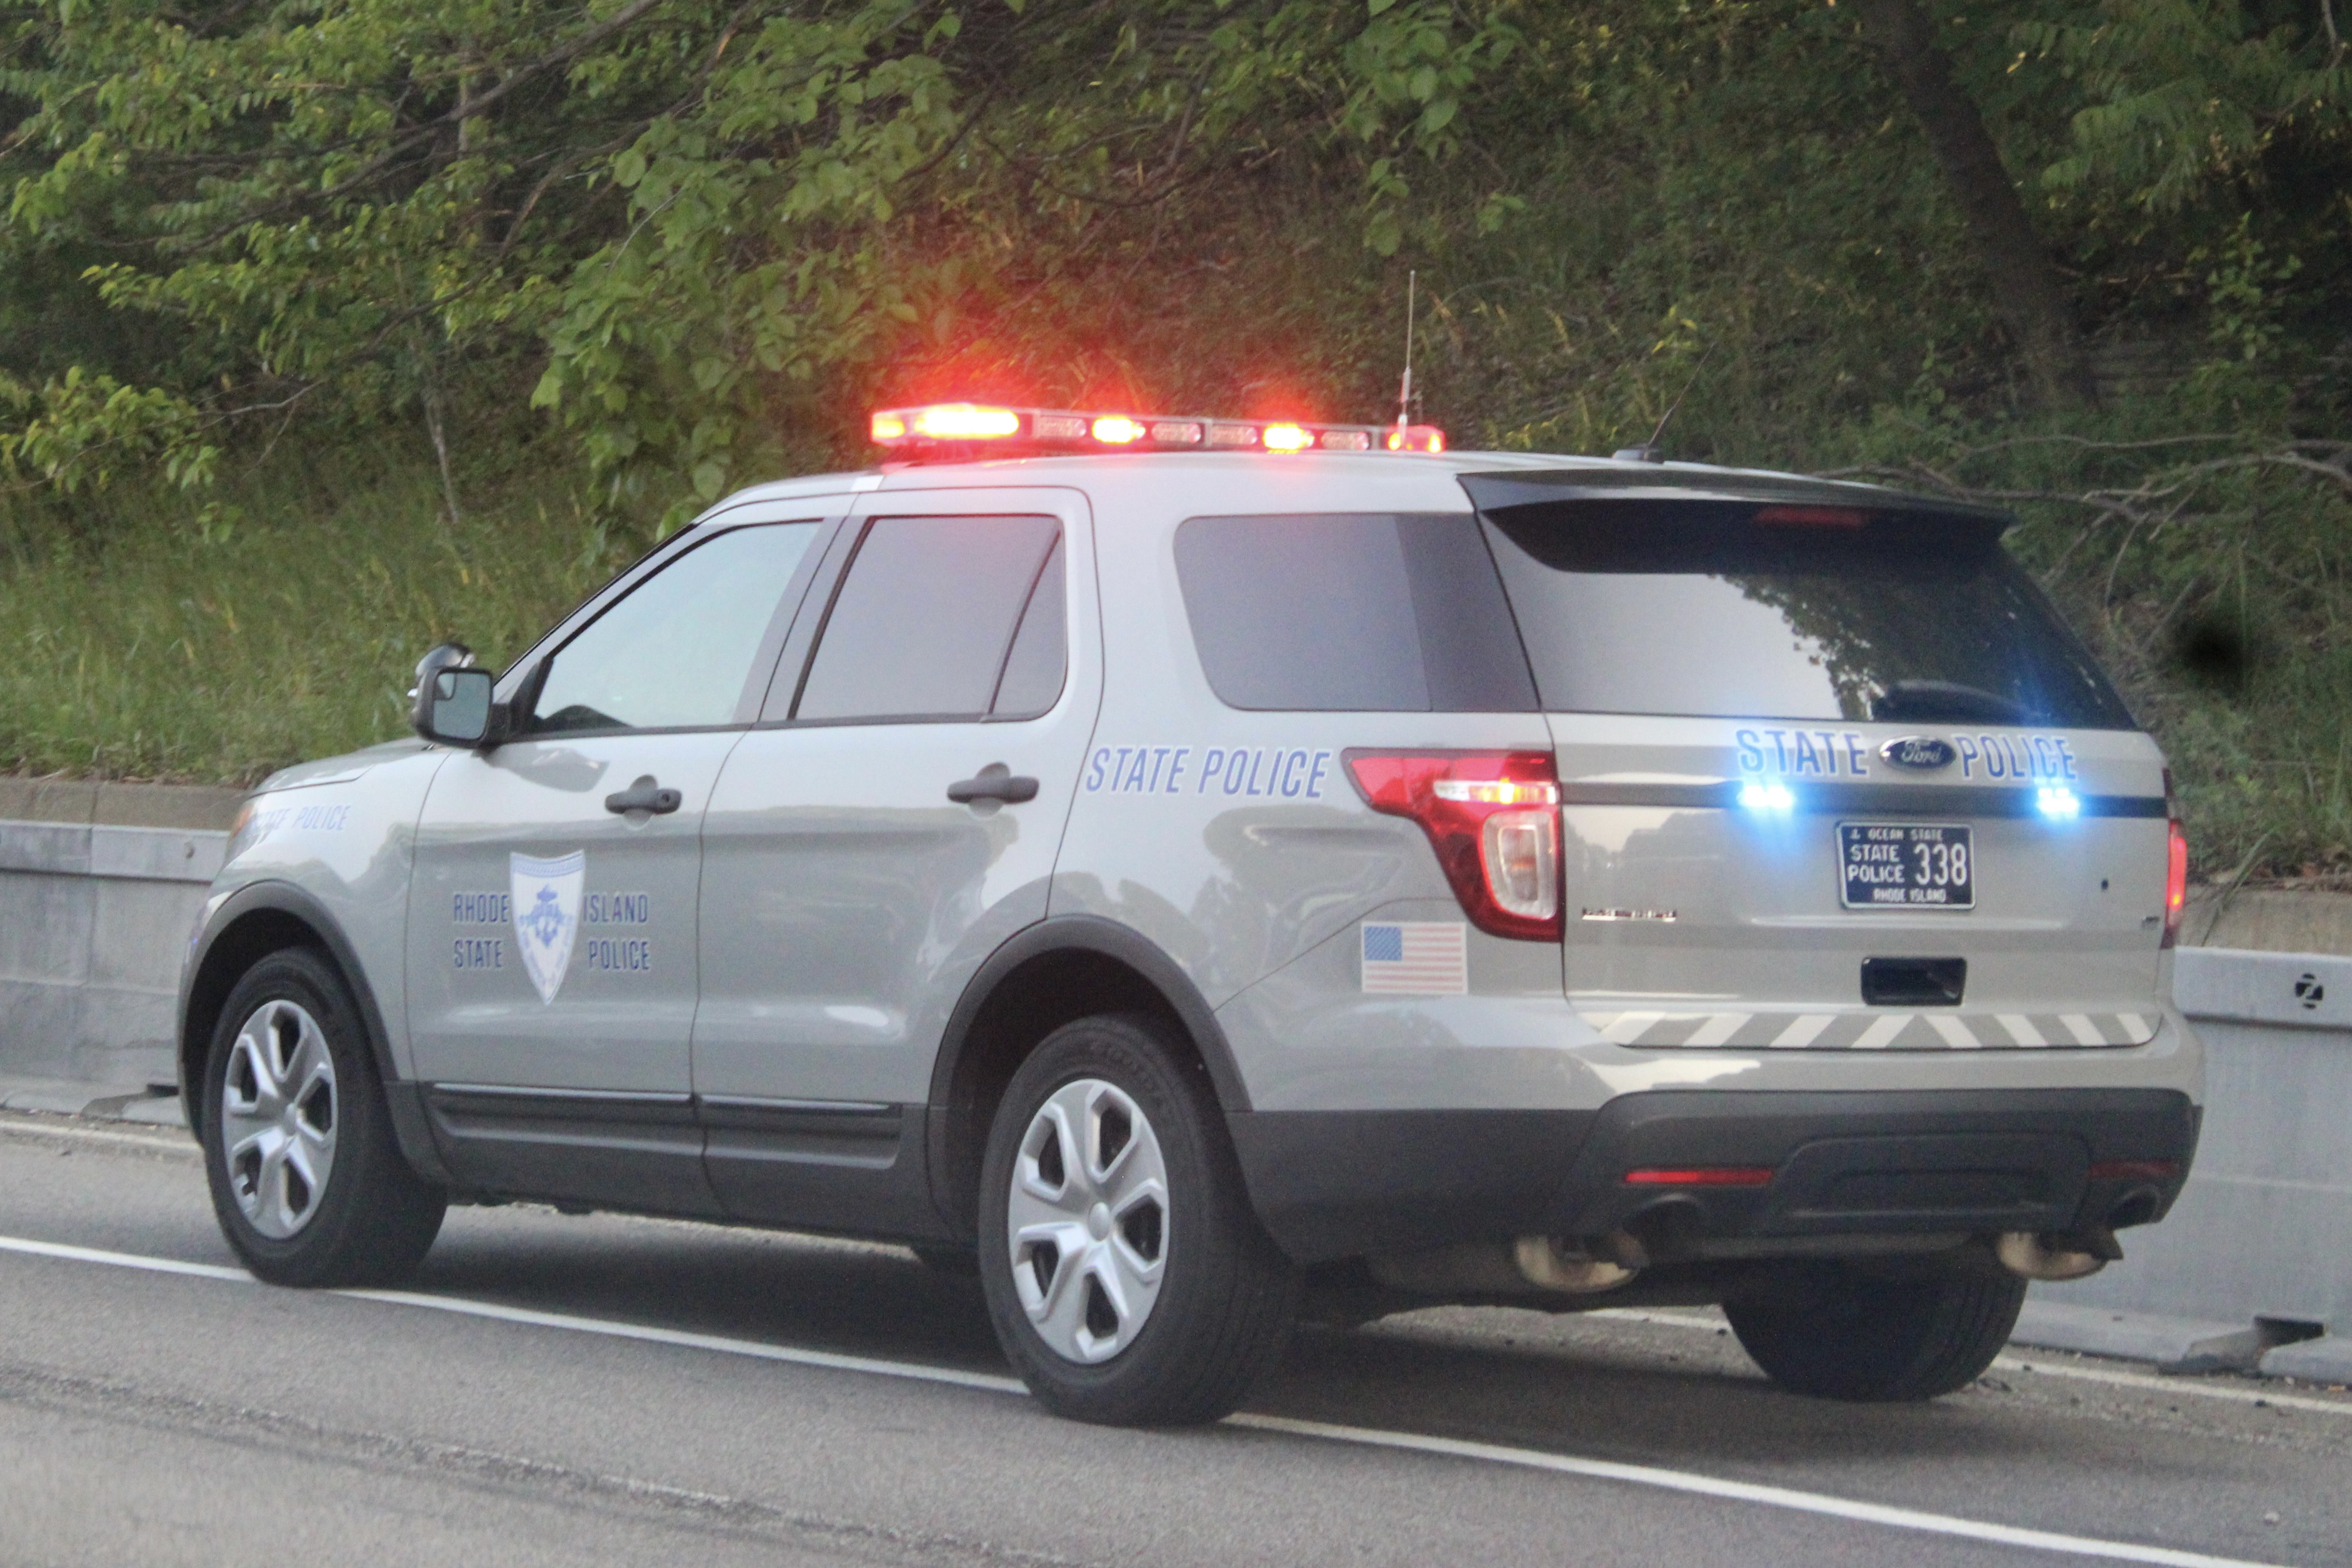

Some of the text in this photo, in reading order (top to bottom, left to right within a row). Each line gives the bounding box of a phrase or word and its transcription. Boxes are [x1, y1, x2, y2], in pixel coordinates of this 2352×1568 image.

[1736, 729, 2077, 779] STATE POLICE
[1901, 739, 1942, 763] Ford
[1085, 747, 1331, 798] STATE POLICE
[292, 805, 351, 831] POLICE
[1867, 827, 1943, 841] OCEAN STATE
[1846, 864, 1906, 883] POLICE
[1849, 842, 1967, 887] STATE 338
[453, 893, 649, 923] RHODE ISLAND
[1872, 888, 1947, 903] RHODE ISLAND
[454, 940, 650, 970] STATE POLICE
